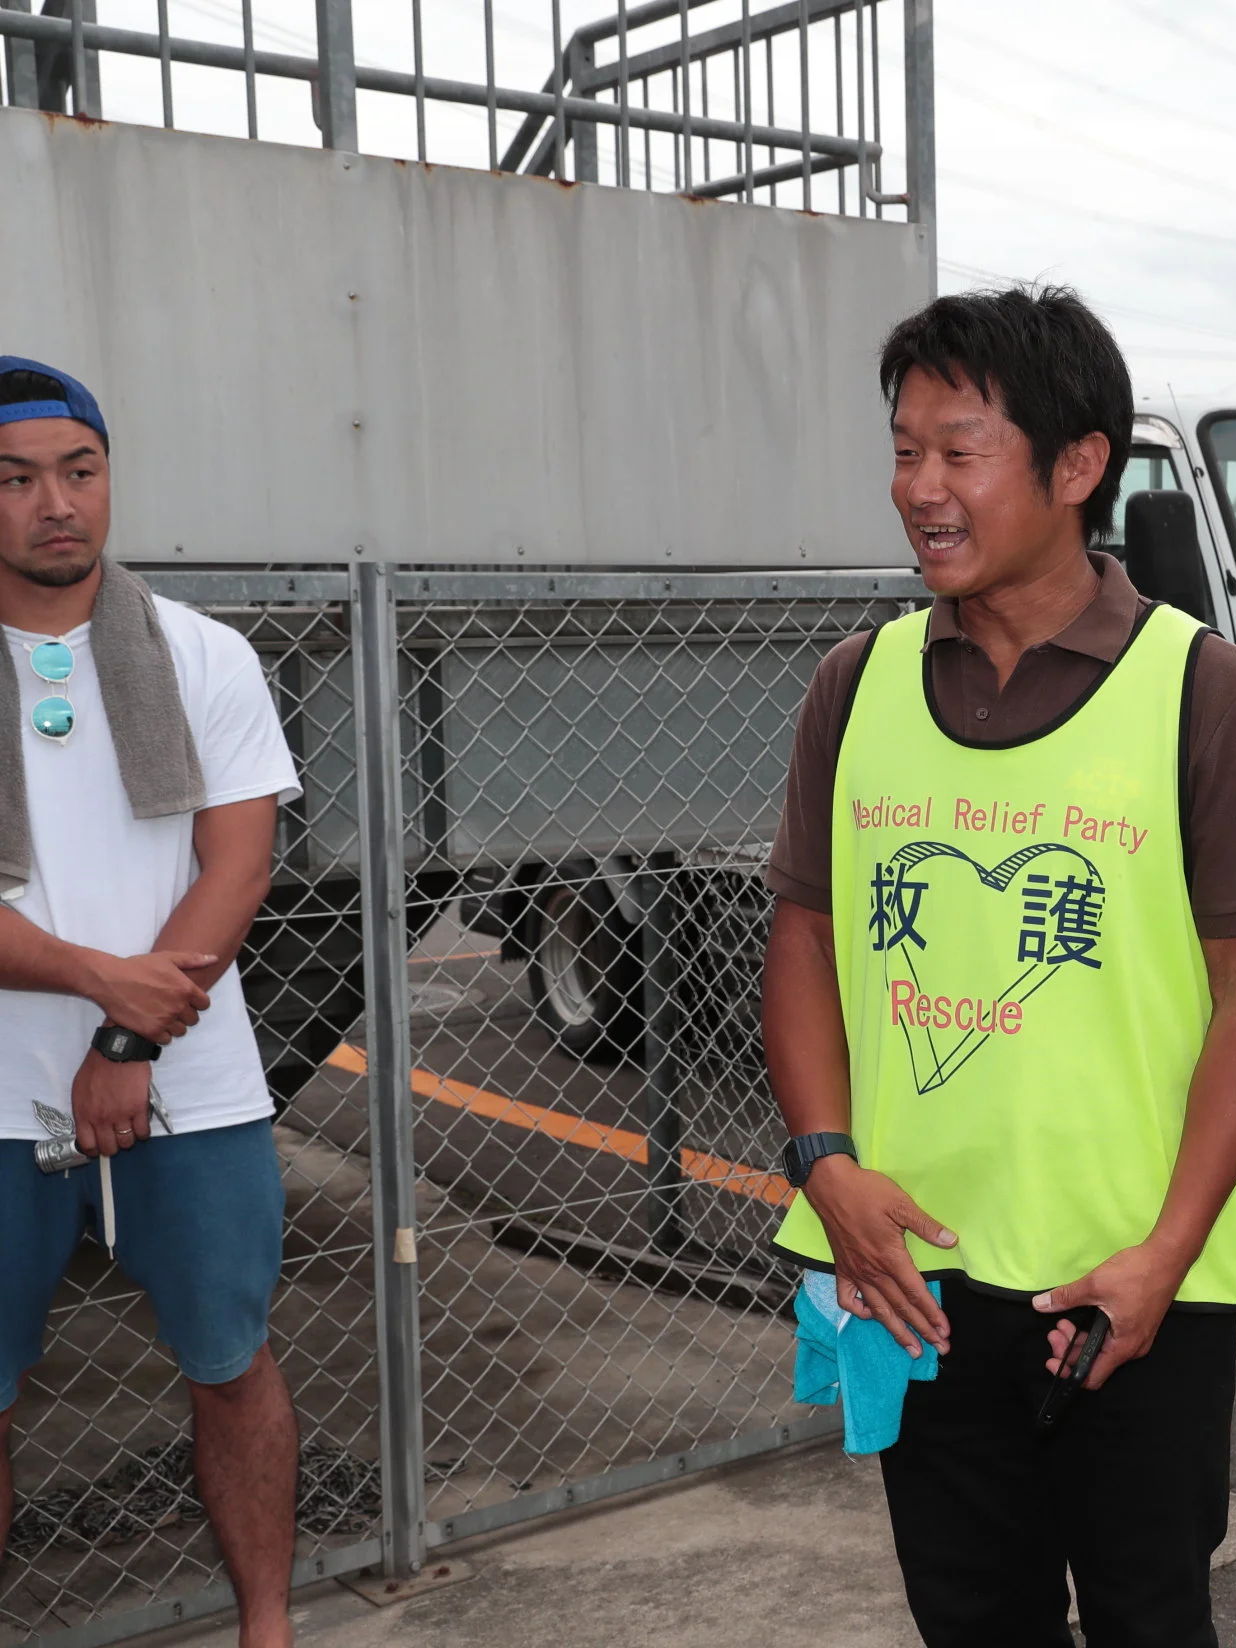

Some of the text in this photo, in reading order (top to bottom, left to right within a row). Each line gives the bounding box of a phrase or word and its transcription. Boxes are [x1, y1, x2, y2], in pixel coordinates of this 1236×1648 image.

[953, 798, 1046, 835] Relief
[1063, 806, 1149, 855] Party
[891, 980, 1023, 1035] Rescue
